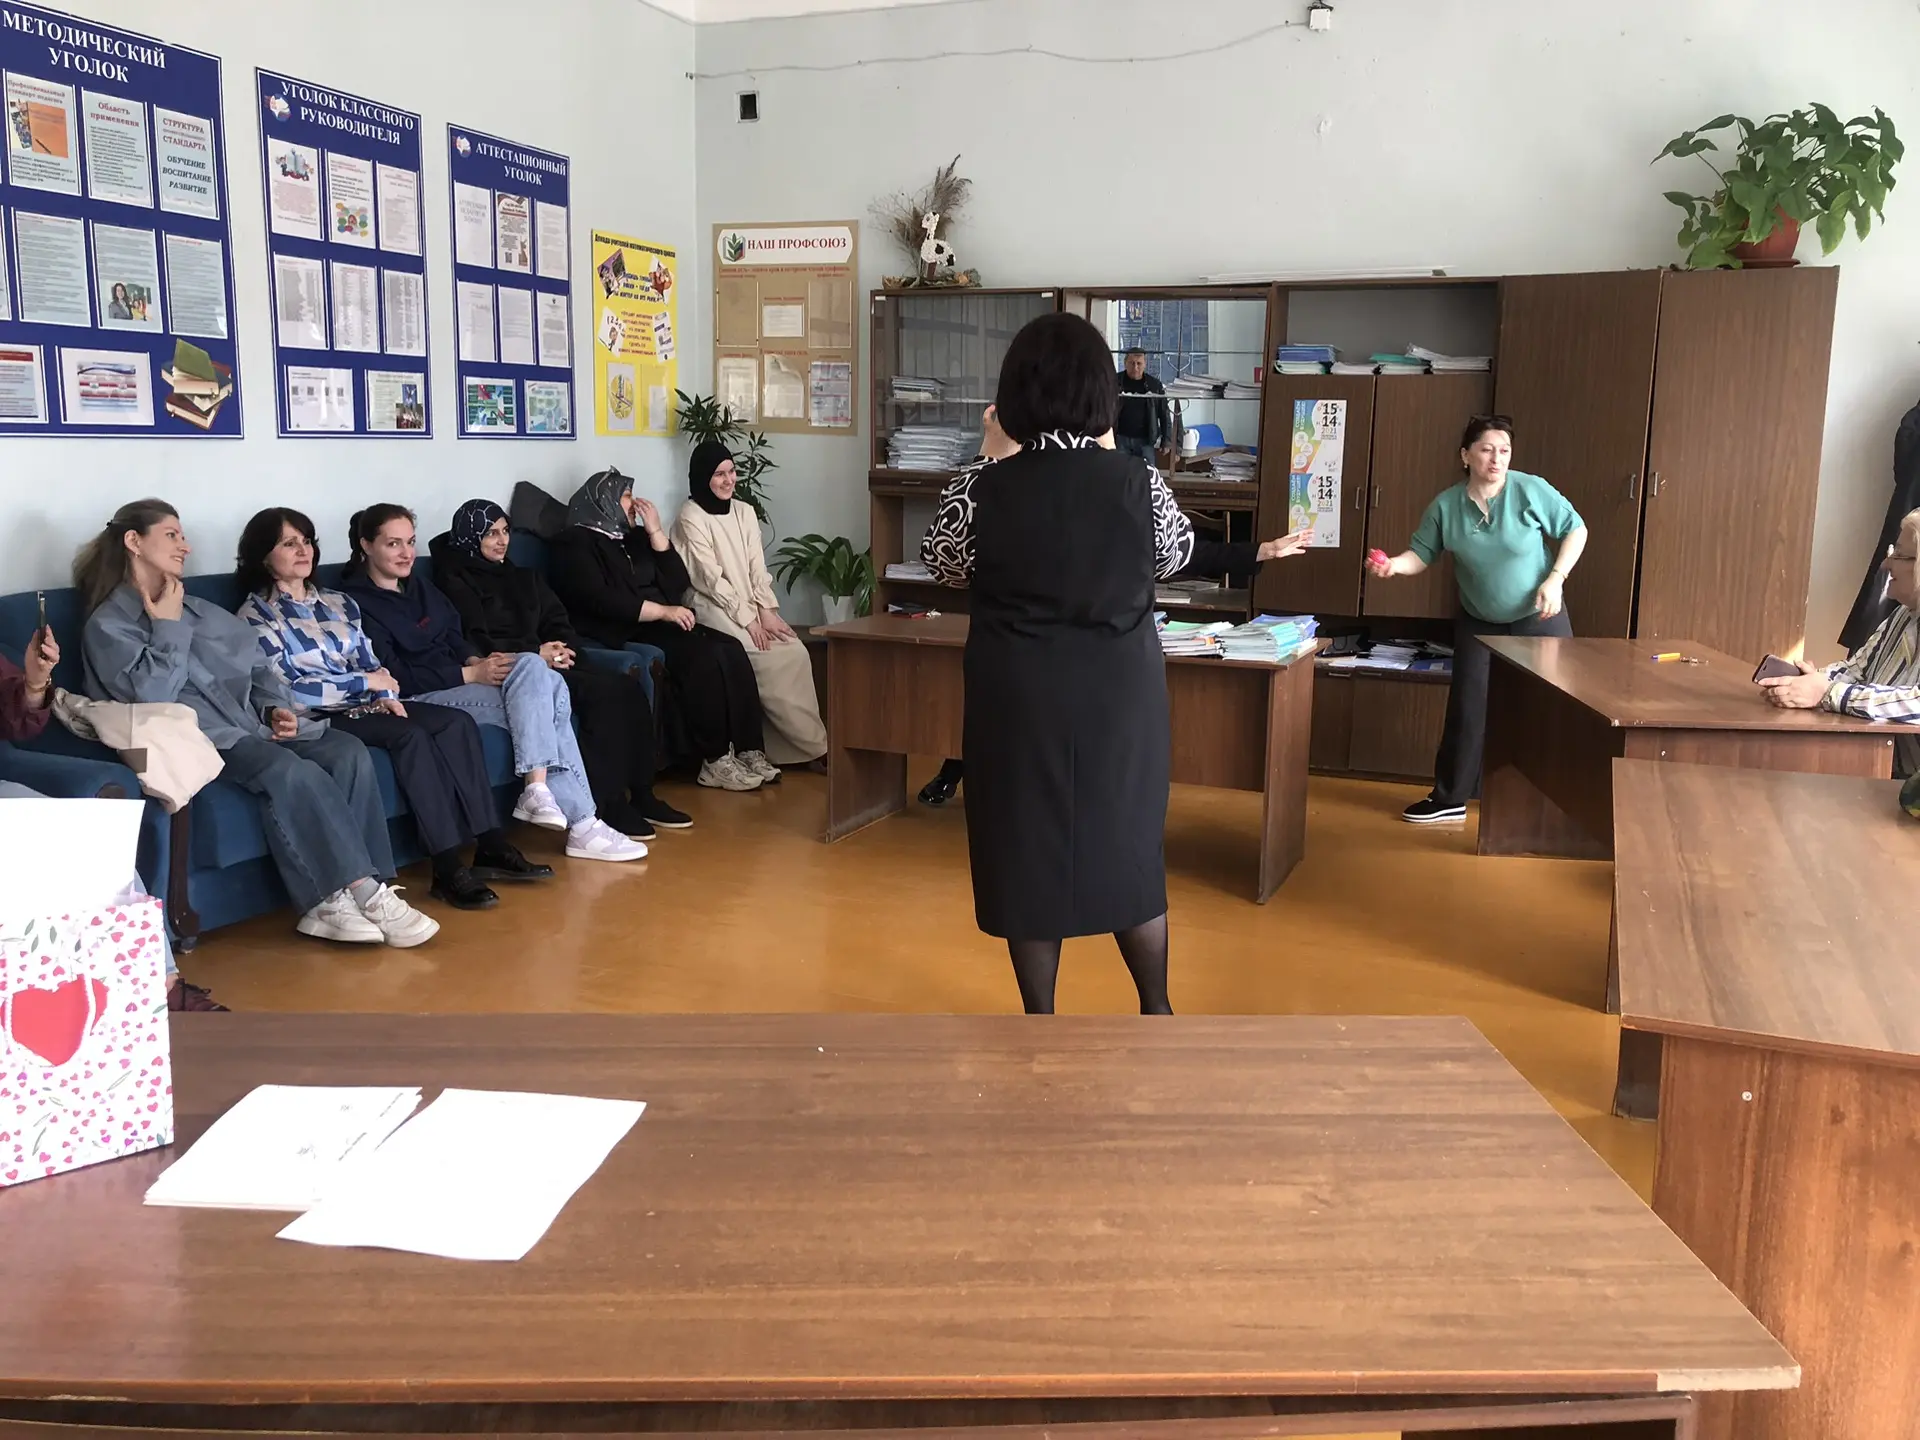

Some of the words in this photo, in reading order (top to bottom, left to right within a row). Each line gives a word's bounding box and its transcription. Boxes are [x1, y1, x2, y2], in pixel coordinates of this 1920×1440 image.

[3, 10, 166, 69] МЕТОДИЧЕСКИЙ
[48, 47, 129, 83] УГОЛОК
[98, 101, 130, 116] Область
[281, 82, 337, 109] УГОЛОК
[340, 98, 414, 131] КЛАССНОГО
[90, 112, 140, 127] применения
[163, 118, 205, 134] СТРУКТУРА
[301, 107, 401, 145] РУКОВОДИТЕЛЯ
[163, 135, 207, 151] СТАНДАРТА
[167, 155, 206, 170] ОБУЧЕНИЕ
[476, 143, 566, 176] АТТЕСТАЦИОННЫЙ
[162, 167, 212, 183] ВОСПИТАНИЕ
[504, 165, 542, 186] УГОЛОК
[169, 181, 208, 195] РАЗВИТИЕ
[747, 239, 775, 250] НАШ
[778, 238, 847, 249] ПРОФСОЮЗ
[1322, 403, 1337, 415] 15
[1322, 415, 1337, 427] 14
[1318, 476, 1333, 487] 15
[1318, 488, 1333, 500] 14
